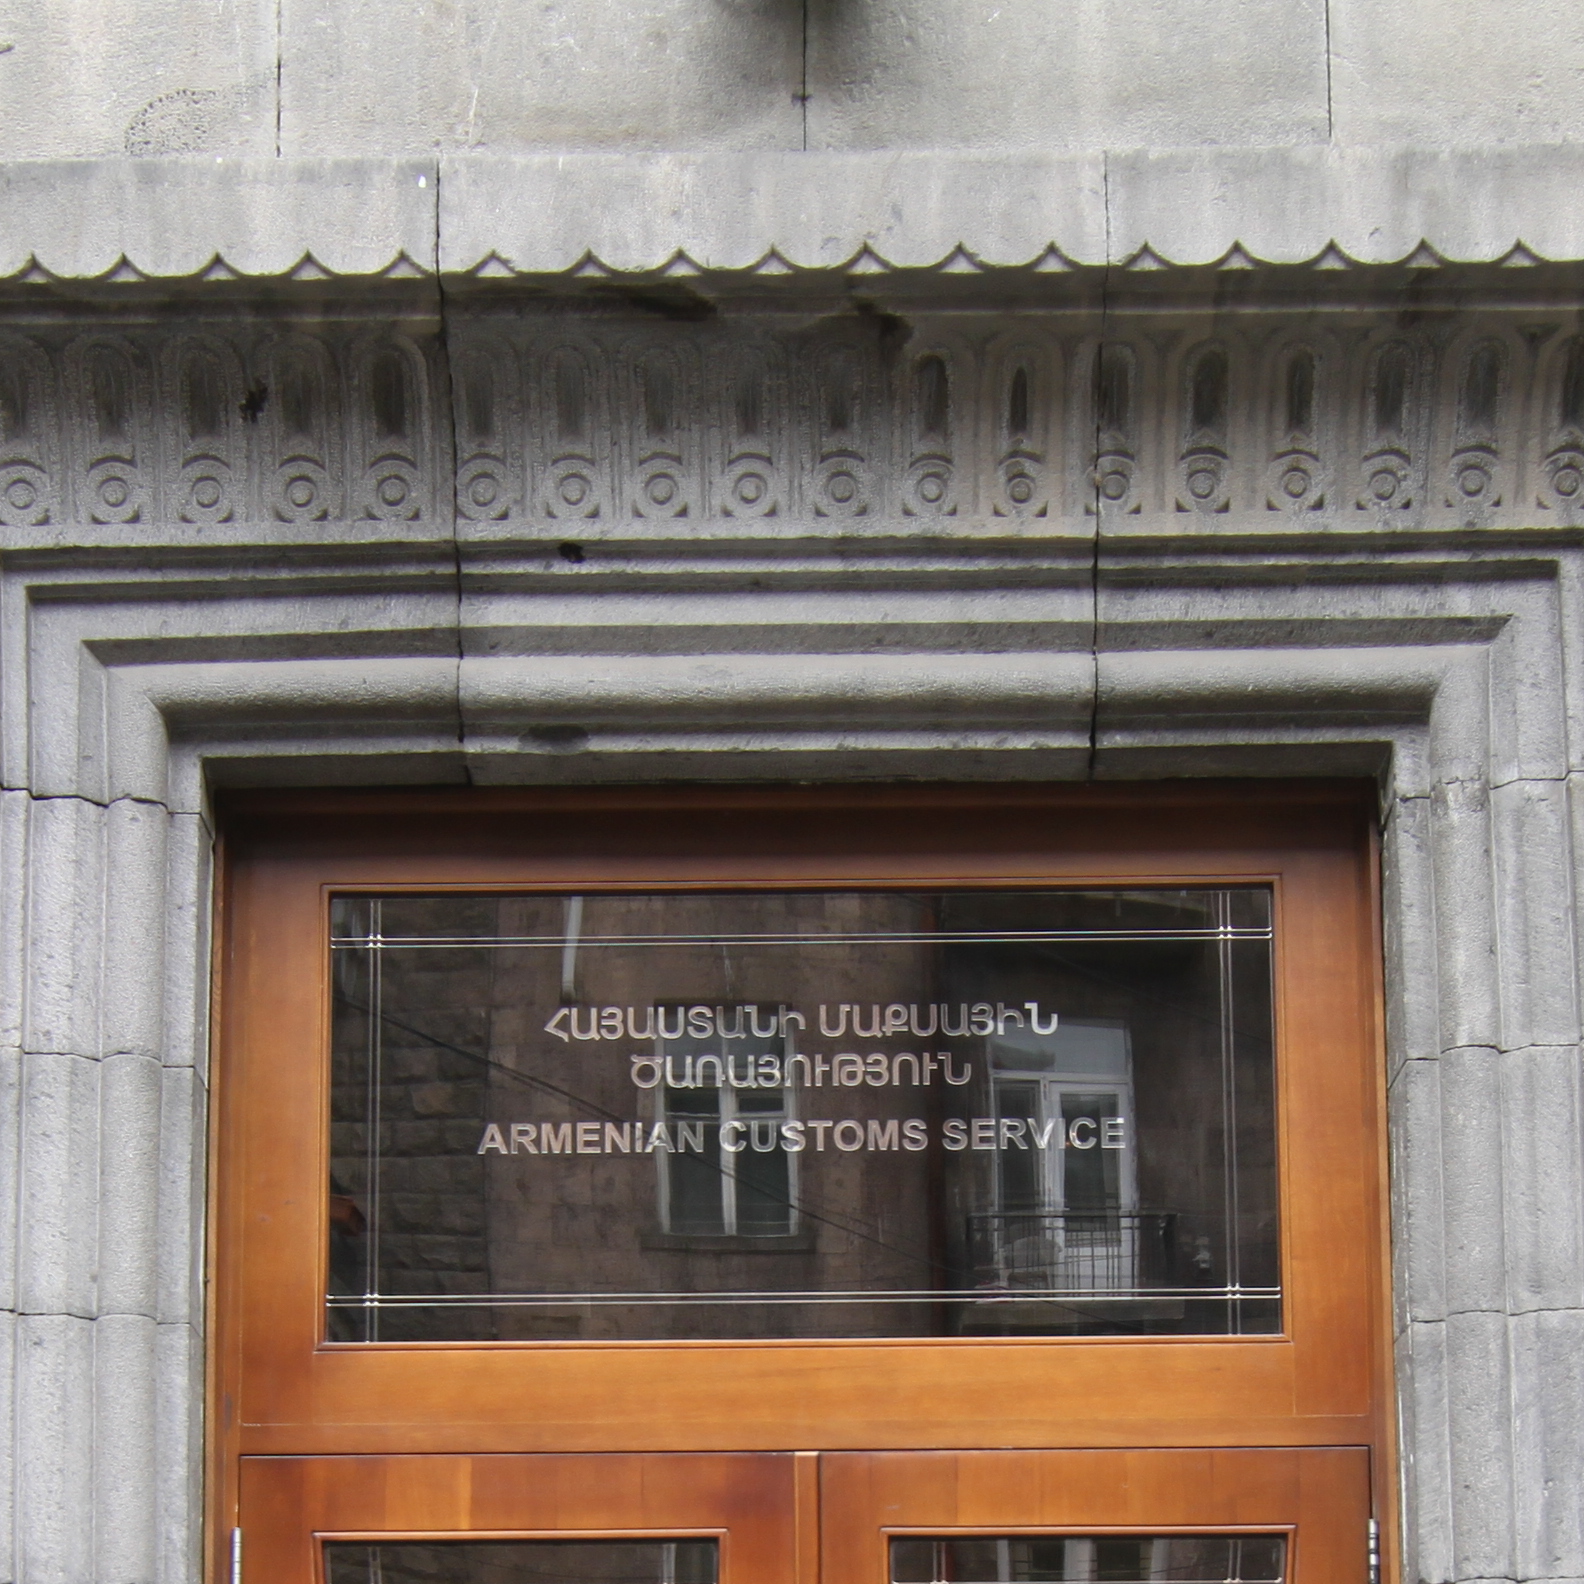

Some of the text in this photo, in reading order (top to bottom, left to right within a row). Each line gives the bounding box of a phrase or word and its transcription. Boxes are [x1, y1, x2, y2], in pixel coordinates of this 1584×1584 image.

[545, 1002, 1059, 1042] ՀԱՅԱՍՏԱՆԻ ՄԱՔՍԱՅԻՆ
[630, 1053, 971, 1088] ԾԱՌԱՅՈՒԹՅՈՒՆ
[478, 1117, 1126, 1155] ARMENIAN CUSTOMS SERVICE
